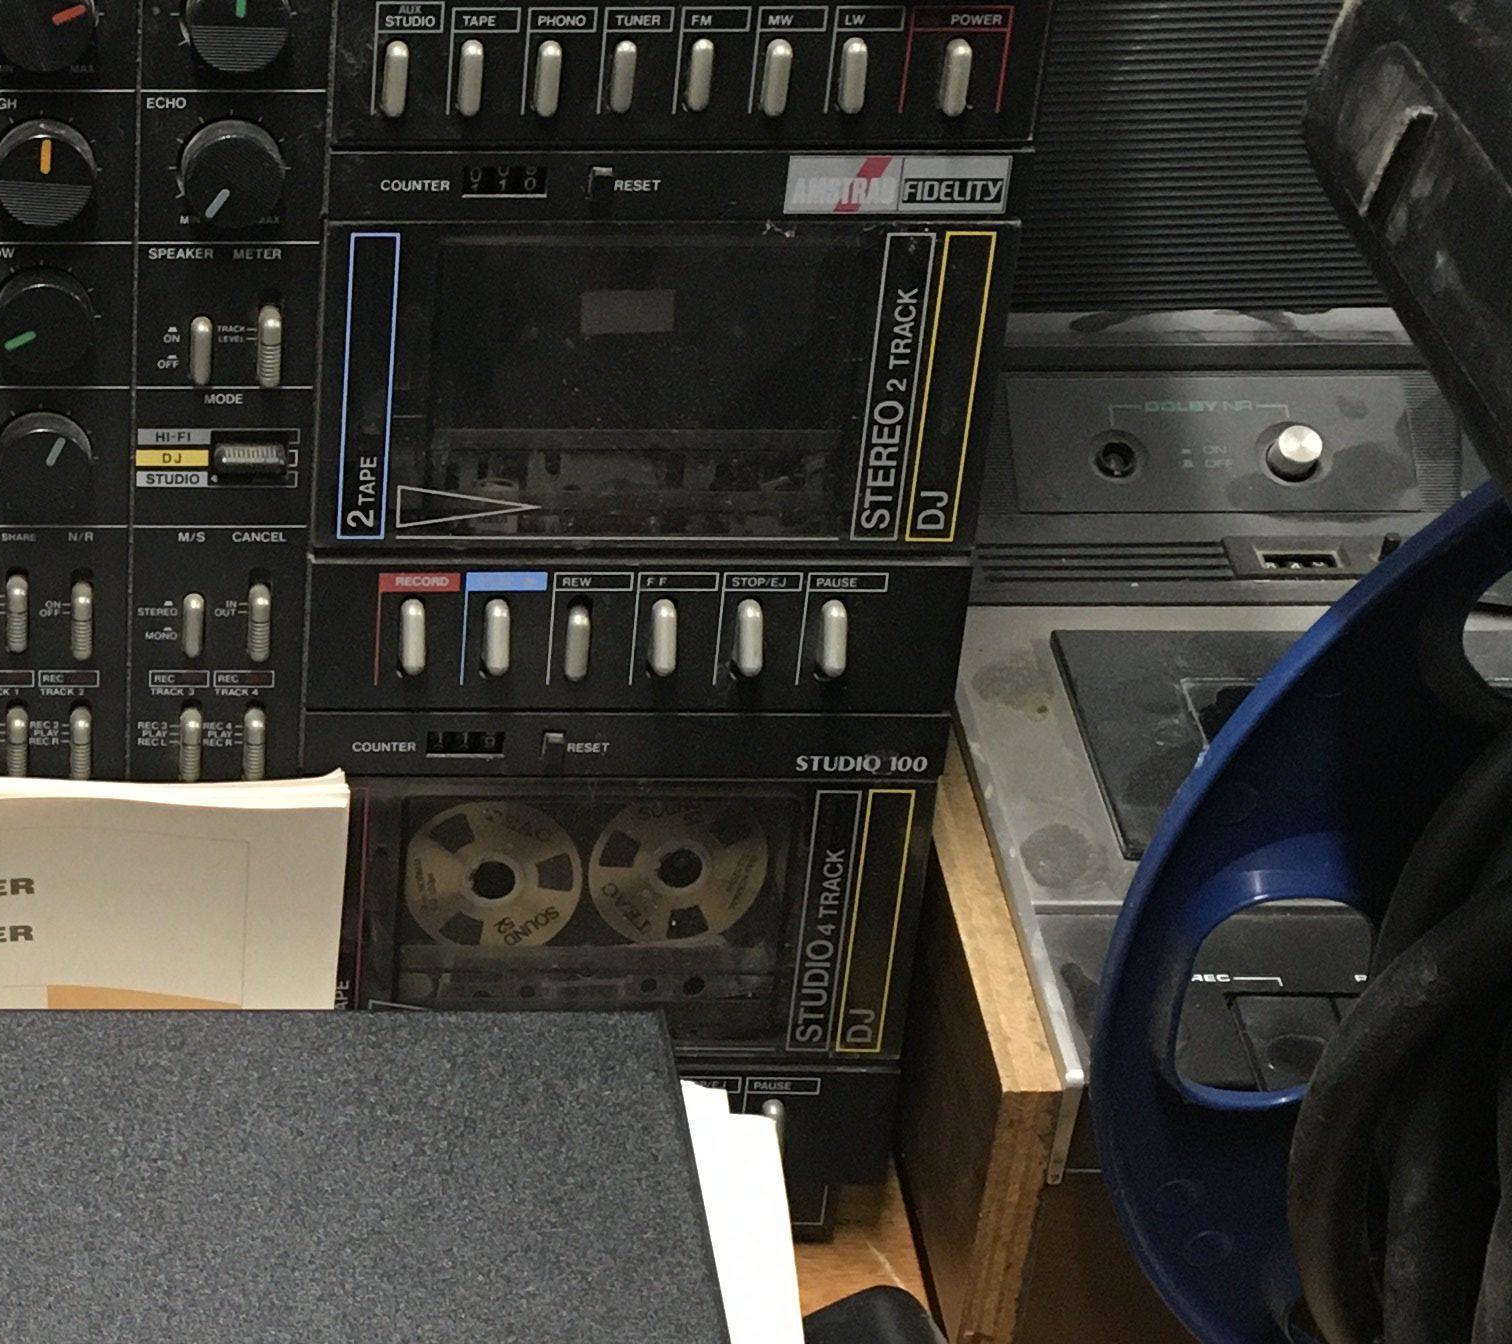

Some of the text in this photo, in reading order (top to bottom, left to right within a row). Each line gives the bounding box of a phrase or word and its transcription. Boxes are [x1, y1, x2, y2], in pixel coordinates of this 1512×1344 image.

[386, 16, 435, 27] STUDIO
[463, 16, 496, 26] TAPE
[538, 15, 586, 26] PHONO
[616, 15, 660, 26] TUNER
[692, 15, 712, 25] FM
[768, 15, 793, 25] MW
[845, 15, 865, 25] LW
[951, 14, 1002, 25] POWER
[147, 97, 186, 109] ECHO
[381, 180, 450, 191] COUNTER
[614, 180, 661, 191] RESET
[903, 177, 1003, 202] FIDELITY
[149, 248, 212, 259] SPEAKER
[234, 248, 281, 260] METER
[205, 393, 243, 404] MODE
[861, 286, 919, 532] STEREO 2 TRACK
[155, 431, 191, 444] HI-FI
[162, 452, 182, 465] DJ
[145, 472, 199, 485] STUDIO
[347, 456, 378, 530] 2 TAPE
[915, 488, 950, 532] DJ
[232, 532, 286, 542] CANCEL
[396, 576, 449, 588] RECORD
[733, 577, 786, 587] STOP/EJ
[138, 608, 178, 616] STEREO
[567, 743, 609, 752] RESET
[796, 755, 928, 773] STUDIO 100
[796, 848, 845, 1044] STUDIO 4 TRACK
[845, 1006, 876, 1044] DJ
